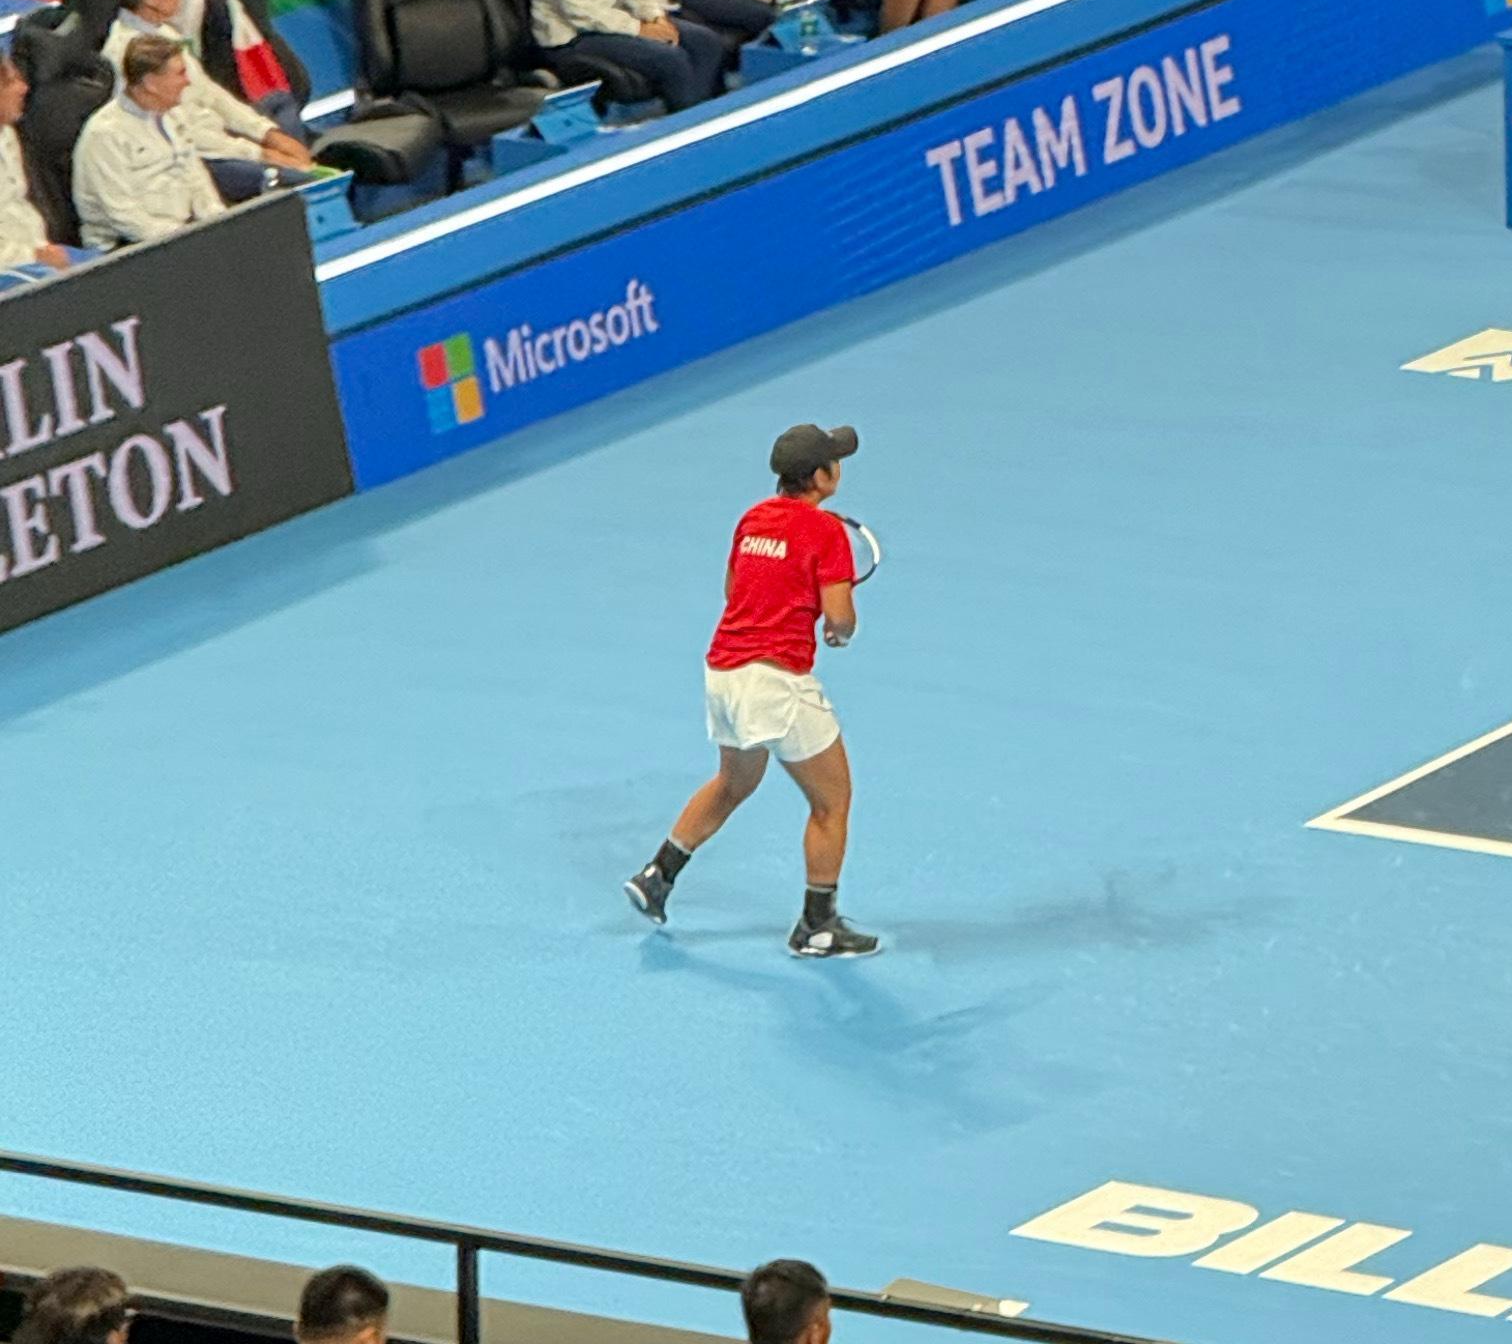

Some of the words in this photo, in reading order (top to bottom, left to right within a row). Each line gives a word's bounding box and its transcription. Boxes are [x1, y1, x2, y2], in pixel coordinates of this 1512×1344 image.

[925, 94, 1088, 226] TEAM
[1092, 32, 1242, 165] ZONE
[0, 315, 146, 459] LIN
[483, 278, 660, 394] Microsoft
[0, 403, 234, 583] ETON
[739, 534, 789, 560] CHINA
